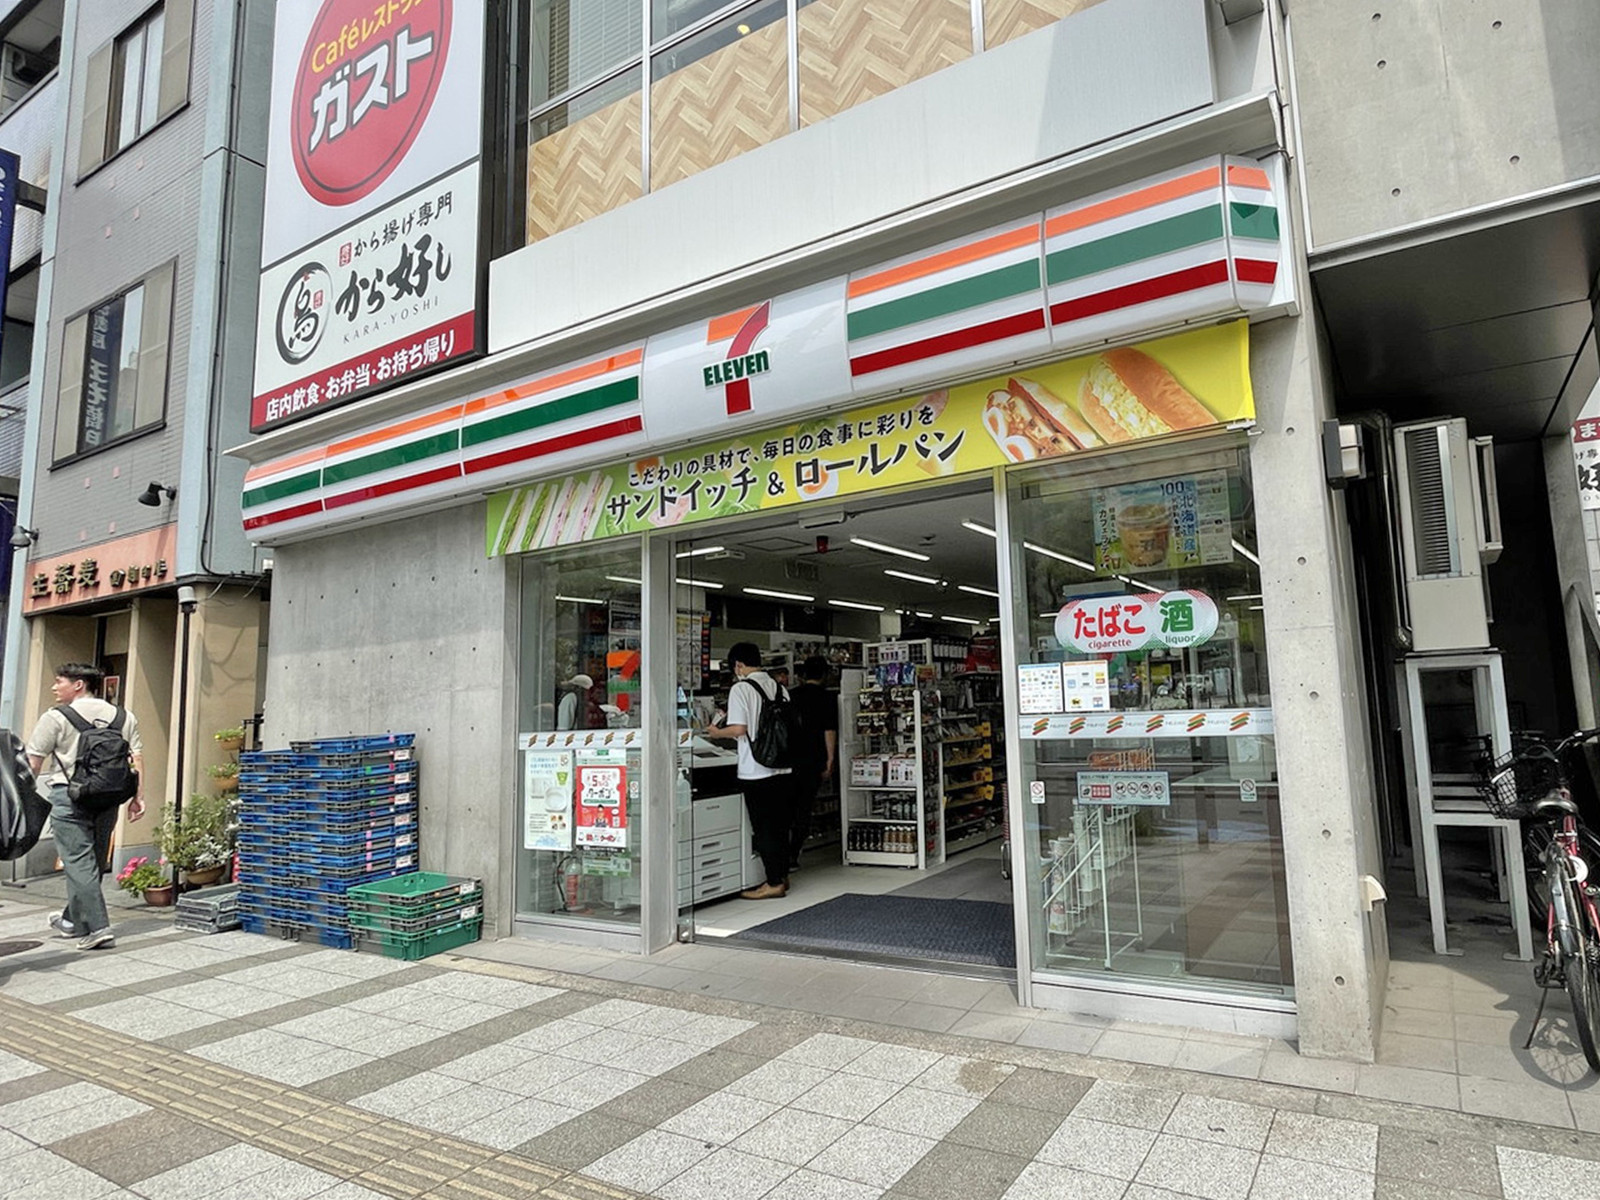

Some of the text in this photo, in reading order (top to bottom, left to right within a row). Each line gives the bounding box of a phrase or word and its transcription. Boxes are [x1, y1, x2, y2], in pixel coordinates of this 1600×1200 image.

[308, 27, 433, 153] ガスト
[354, 191, 453, 258] から揚げ専門
[335, 233, 452, 322] から好し
[343, 295, 440, 345] KARA-YOSHI
[606, 430, 965, 526] サンドイッチ & ロールパン
[630, 405, 935, 487] こだわりの具材で、毎日の食事に彩りを
[1073, 598, 1194, 639] たばこ 酒
[1088, 634, 1196, 650] cigarette liquor
